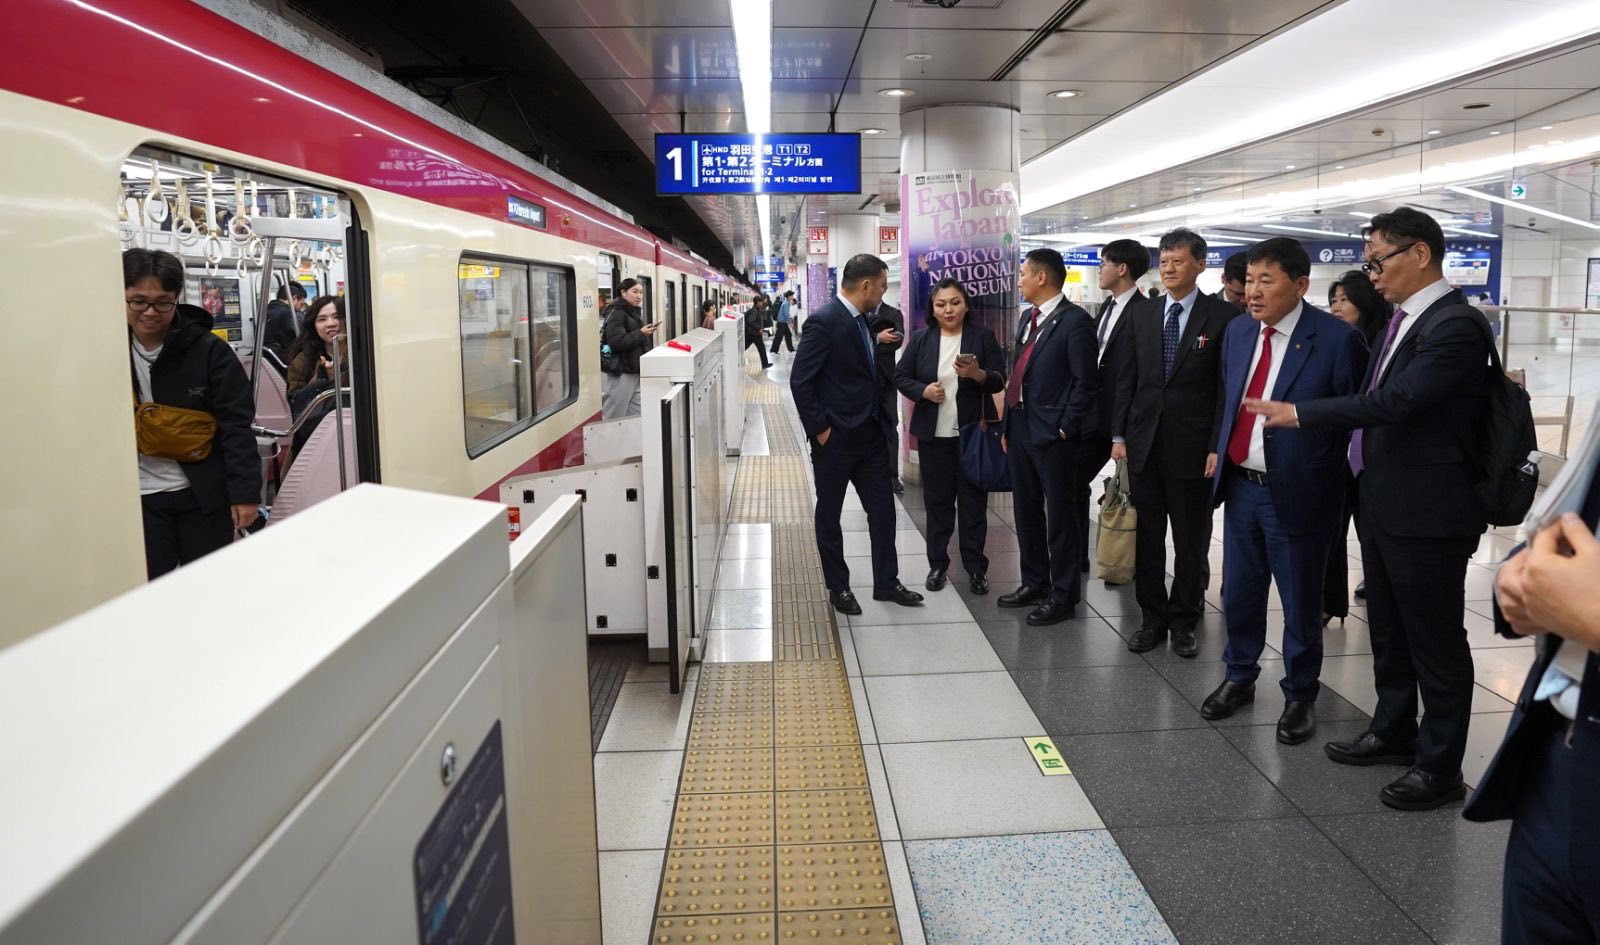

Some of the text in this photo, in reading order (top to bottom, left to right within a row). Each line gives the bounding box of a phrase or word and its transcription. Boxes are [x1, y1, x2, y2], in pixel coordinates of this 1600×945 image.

[779, 146, 790, 154] T1
[797, 146, 808, 154] T2
[666, 147, 683, 181] 1
[702, 168, 715, 176] for
[718, 168, 757, 176] Termina
[929, 215, 1008, 250] Japan
[942, 247, 1003, 268] TOKYO
[929, 260, 1014, 286] NATIONAL
[964, 276, 1012, 298] SEUM
